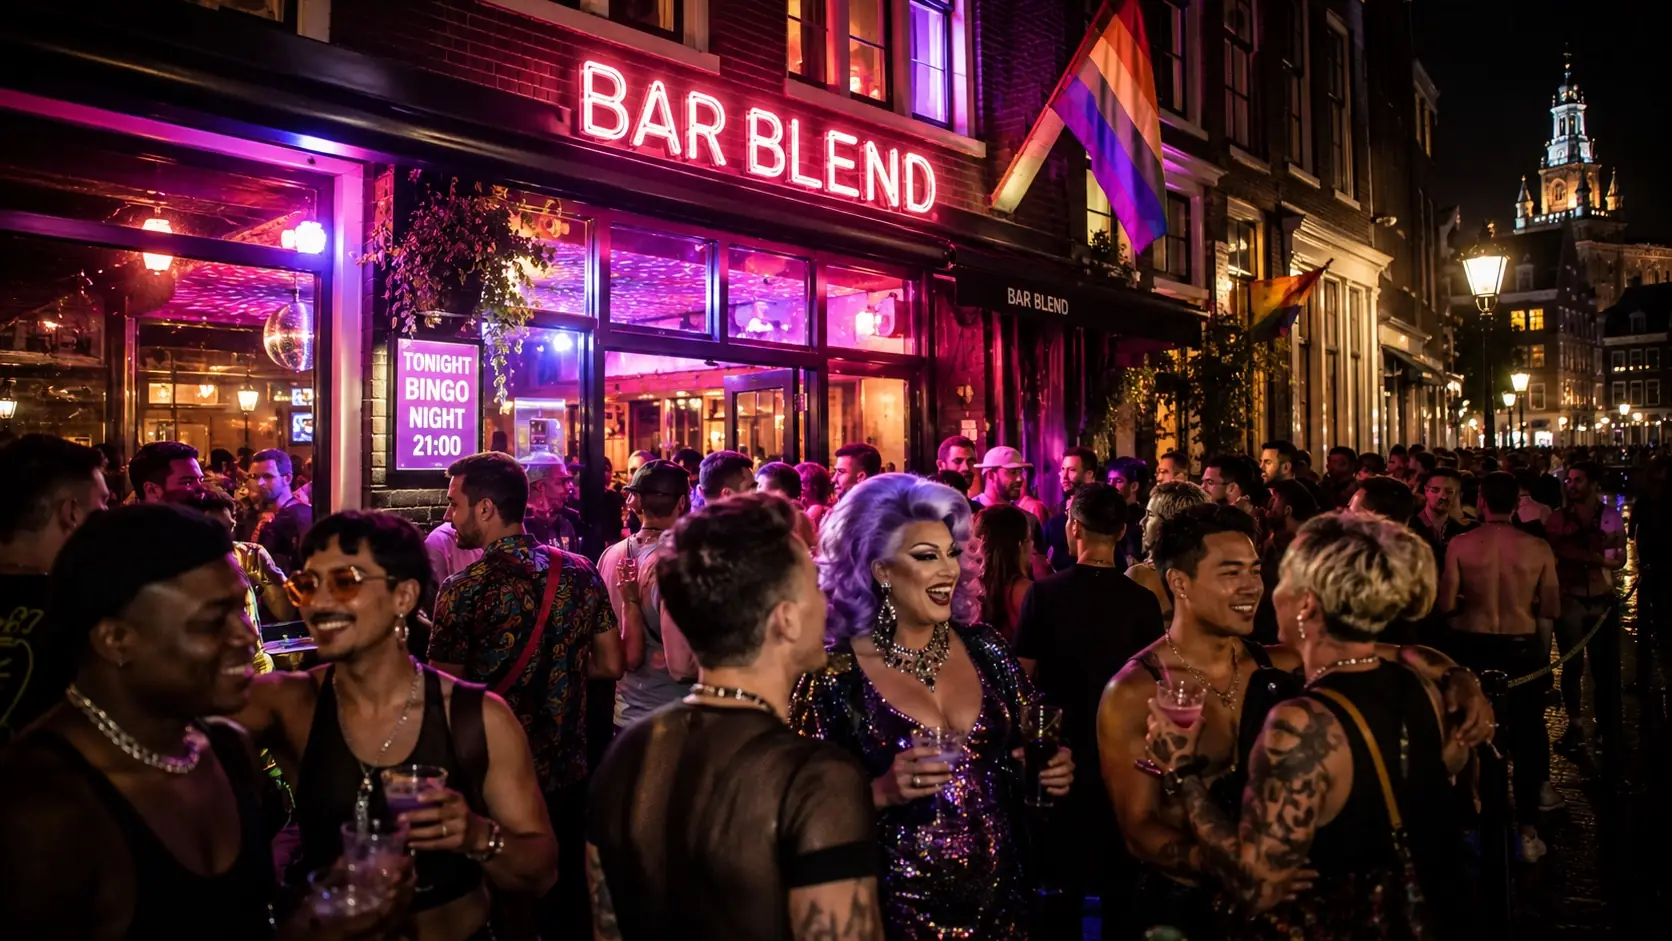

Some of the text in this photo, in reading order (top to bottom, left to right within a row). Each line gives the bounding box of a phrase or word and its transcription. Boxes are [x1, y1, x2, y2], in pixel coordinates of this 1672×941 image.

[579, 60, 937, 213] BAR BLEND
[1007, 287, 1069, 315] BAR BLEND
[403, 352, 472, 374] TONIGHT
[405, 377, 469, 402] BINGO
[409, 406, 465, 429] NIGHT
[412, 434, 461, 456] 21:00
